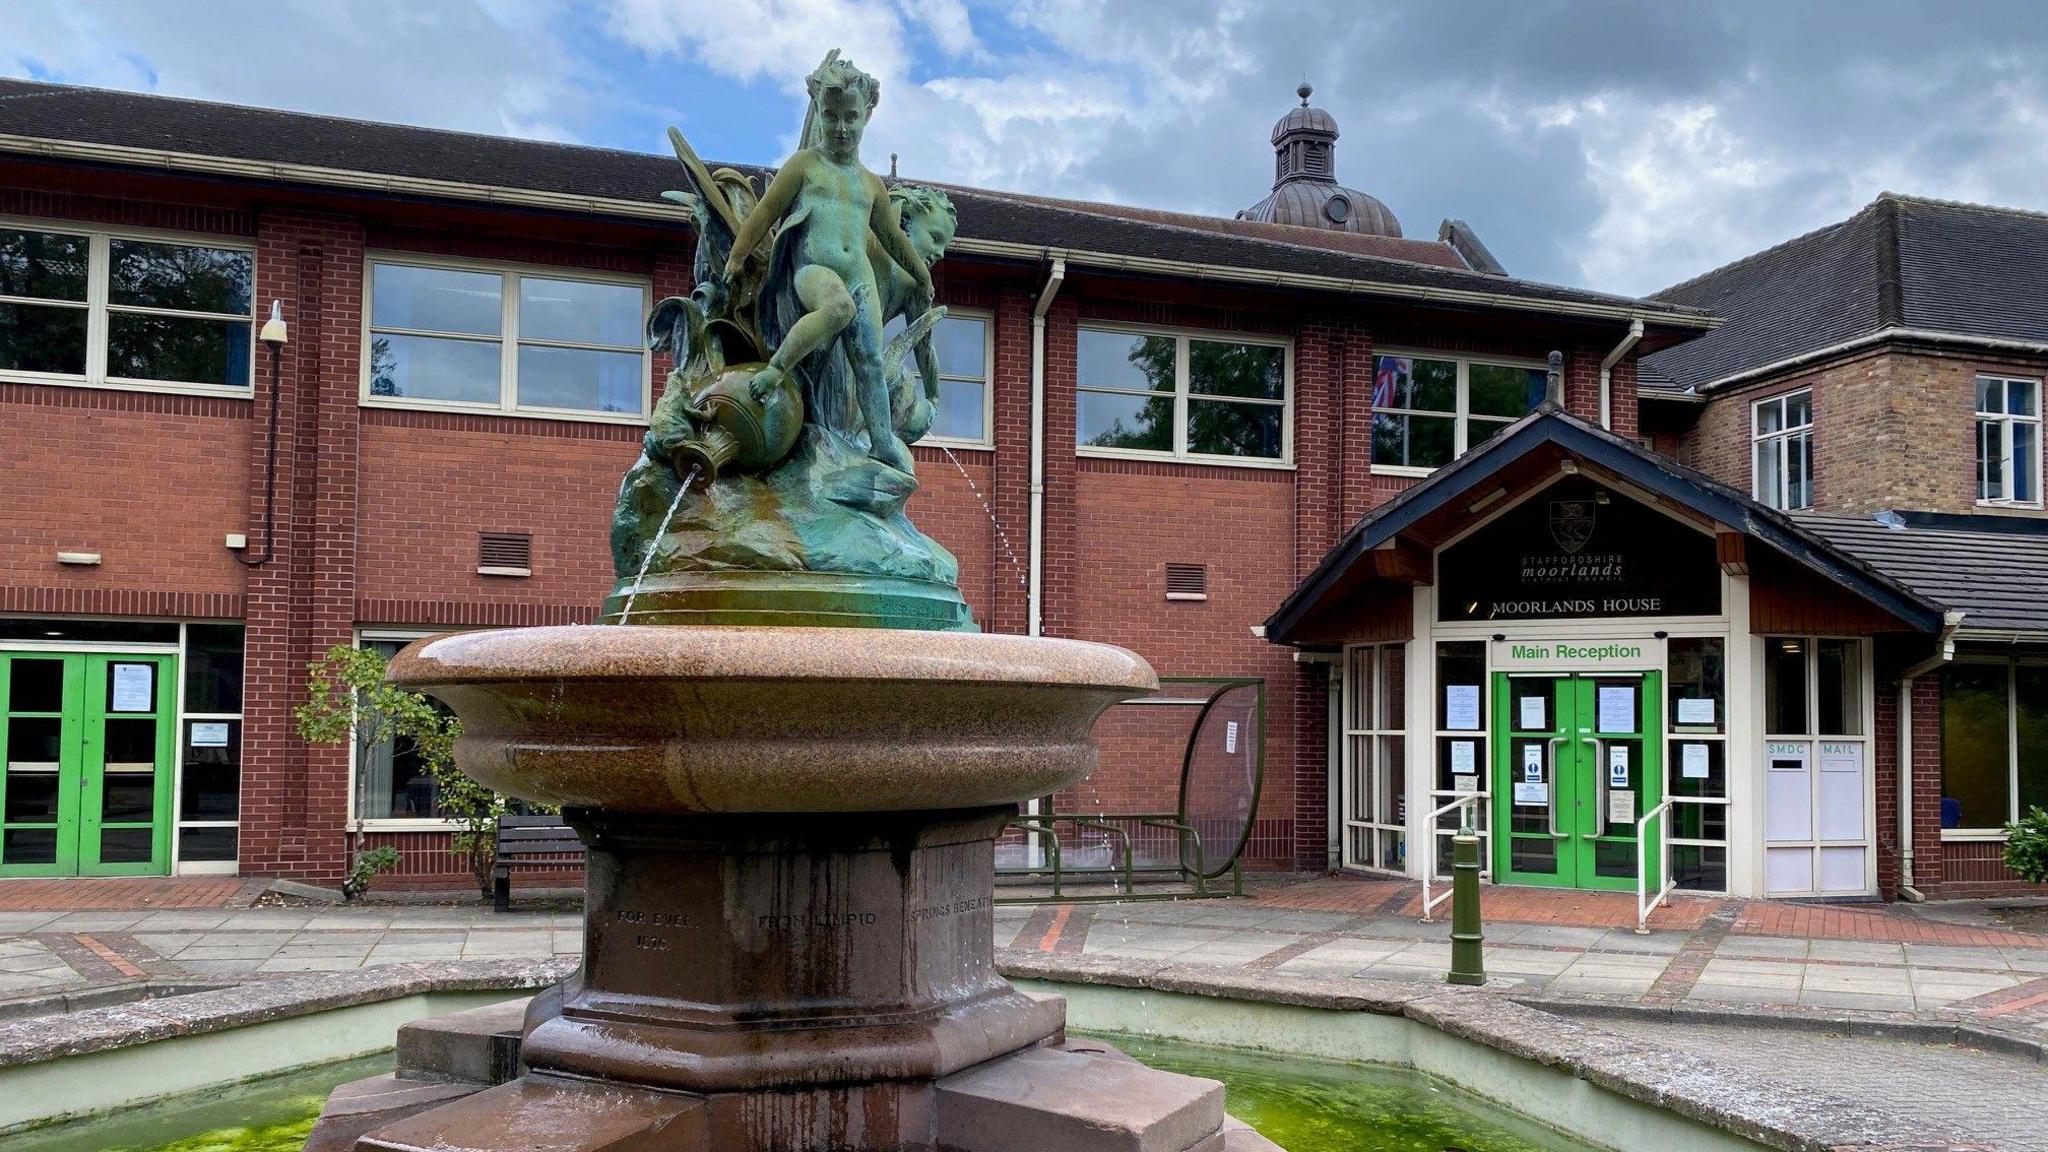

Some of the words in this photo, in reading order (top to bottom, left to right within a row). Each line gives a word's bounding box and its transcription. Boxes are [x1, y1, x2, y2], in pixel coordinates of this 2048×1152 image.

[1521, 555, 1623, 566] STAFFORDSHIRE
[1521, 563, 1622, 577] moorlands
[1492, 600, 1595, 614] MOORLANDS
[1603, 598, 1661, 611] HOUSE
[1512, 645, 1549, 658] Main
[1556, 644, 1641, 661] Reception
[1769, 744, 1804, 754] SMDC
[1823, 744, 1854, 754] MAIL
[617, 911, 646, 924] FOR
[910, 904, 951, 921] SPRINGS
